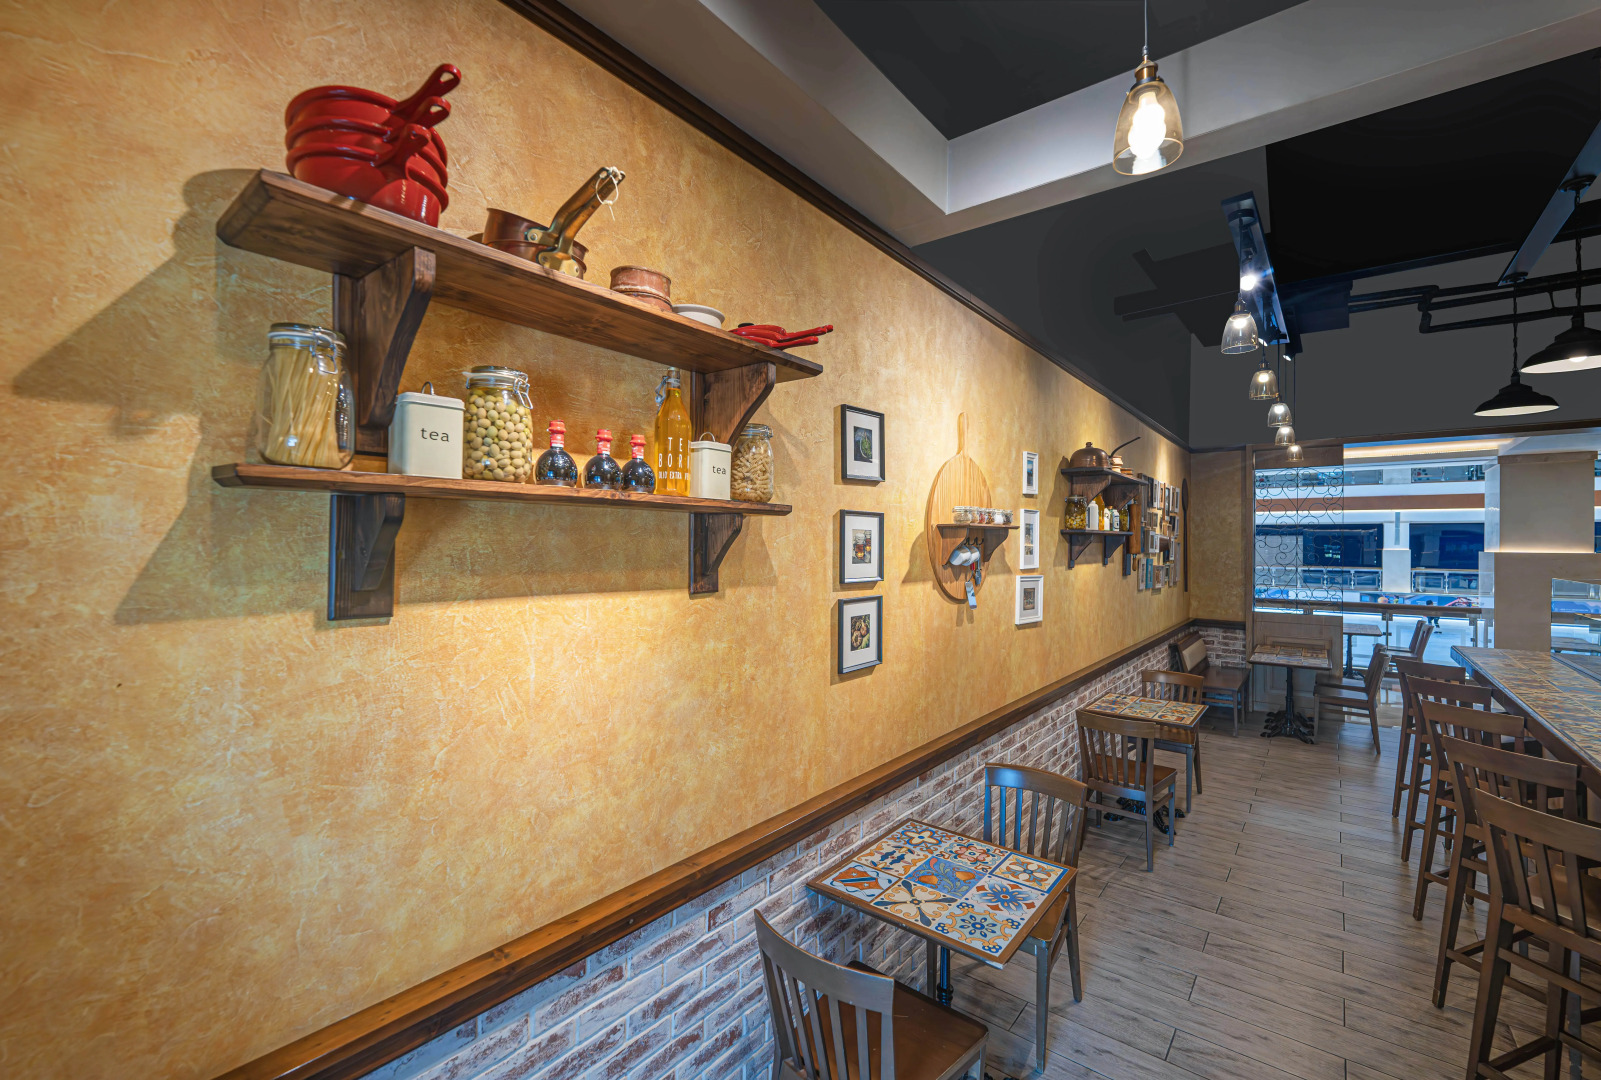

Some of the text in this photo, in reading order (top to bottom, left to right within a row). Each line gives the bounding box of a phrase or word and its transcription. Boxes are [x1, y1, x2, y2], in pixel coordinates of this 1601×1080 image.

[420, 427, 450, 443] tea
[668, 437, 690, 453] TE
[658, 453, 690, 469] BOR
[669, 471, 682, 480] EXTRA
[712, 465, 727, 475] tea
